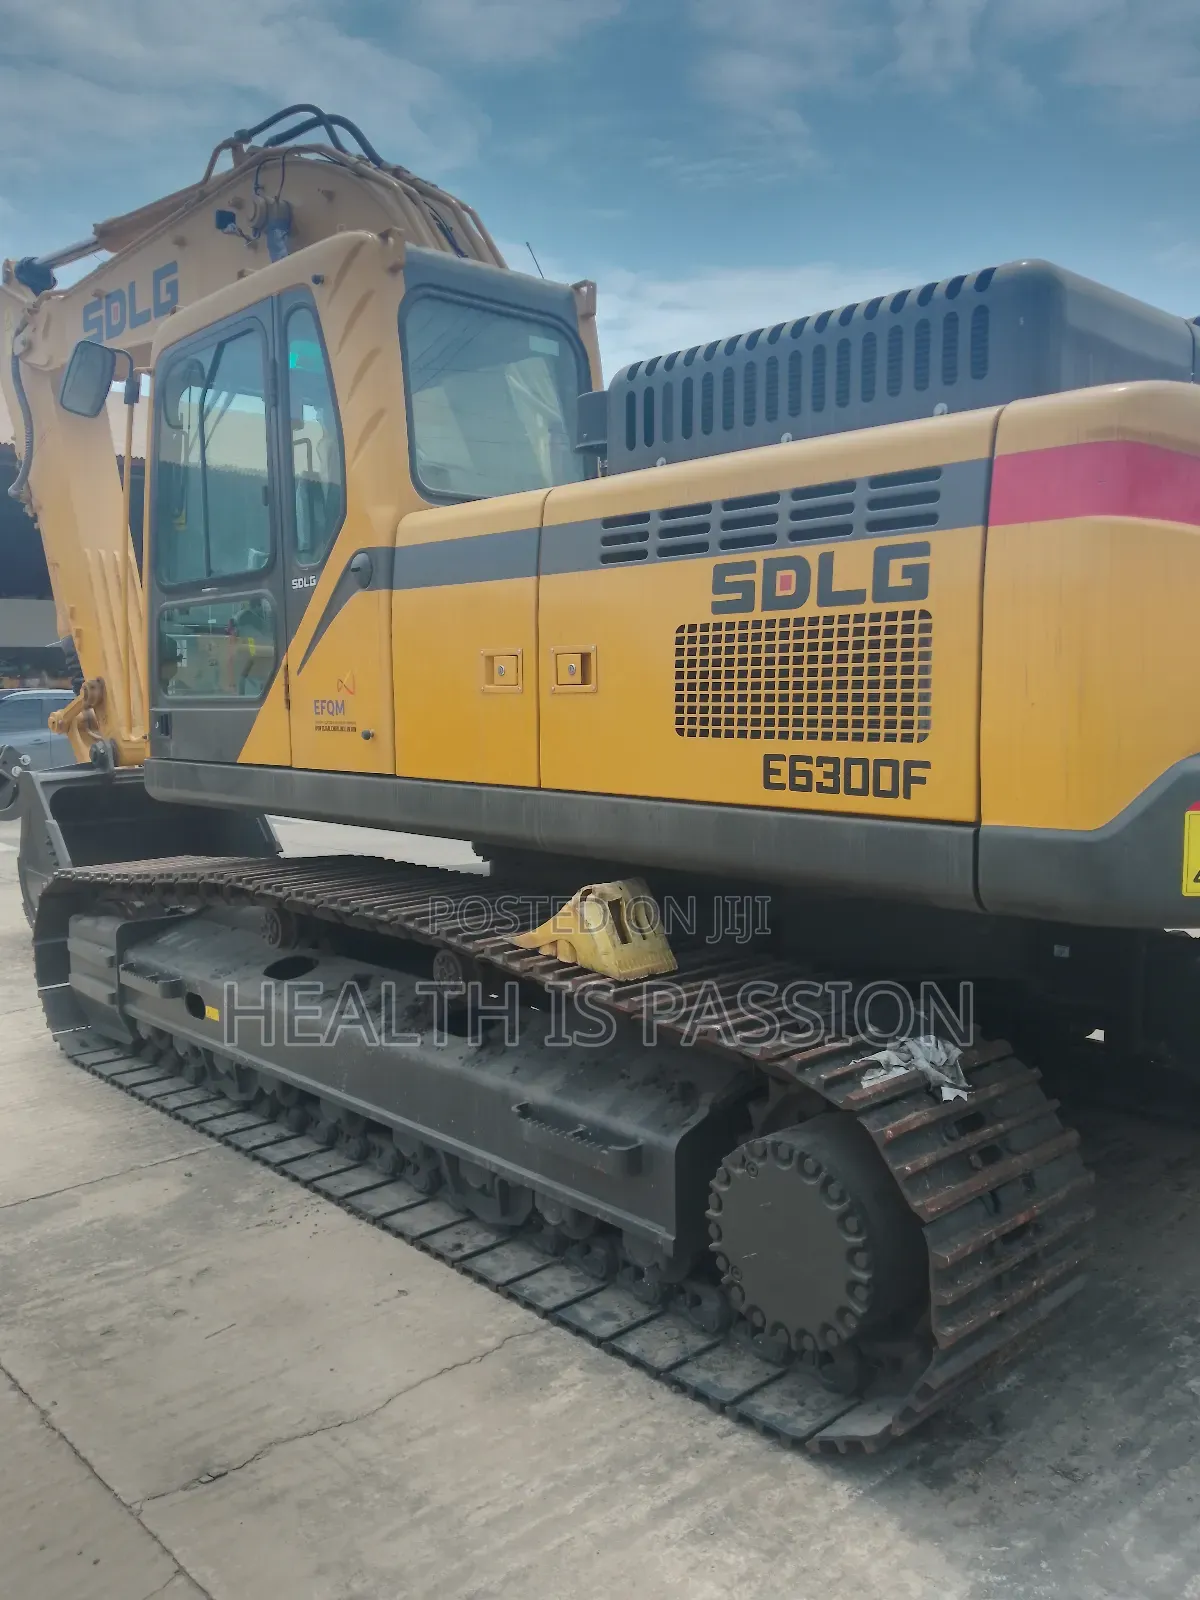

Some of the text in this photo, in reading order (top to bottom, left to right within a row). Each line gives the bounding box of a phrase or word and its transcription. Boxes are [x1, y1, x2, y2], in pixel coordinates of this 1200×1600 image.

[83, 260, 179, 345] SDLG
[291, 575, 317, 590] SDLG
[711, 541, 931, 615] SDLG
[313, 699, 346, 716] EFQM
[763, 753, 932, 800] E6300F
